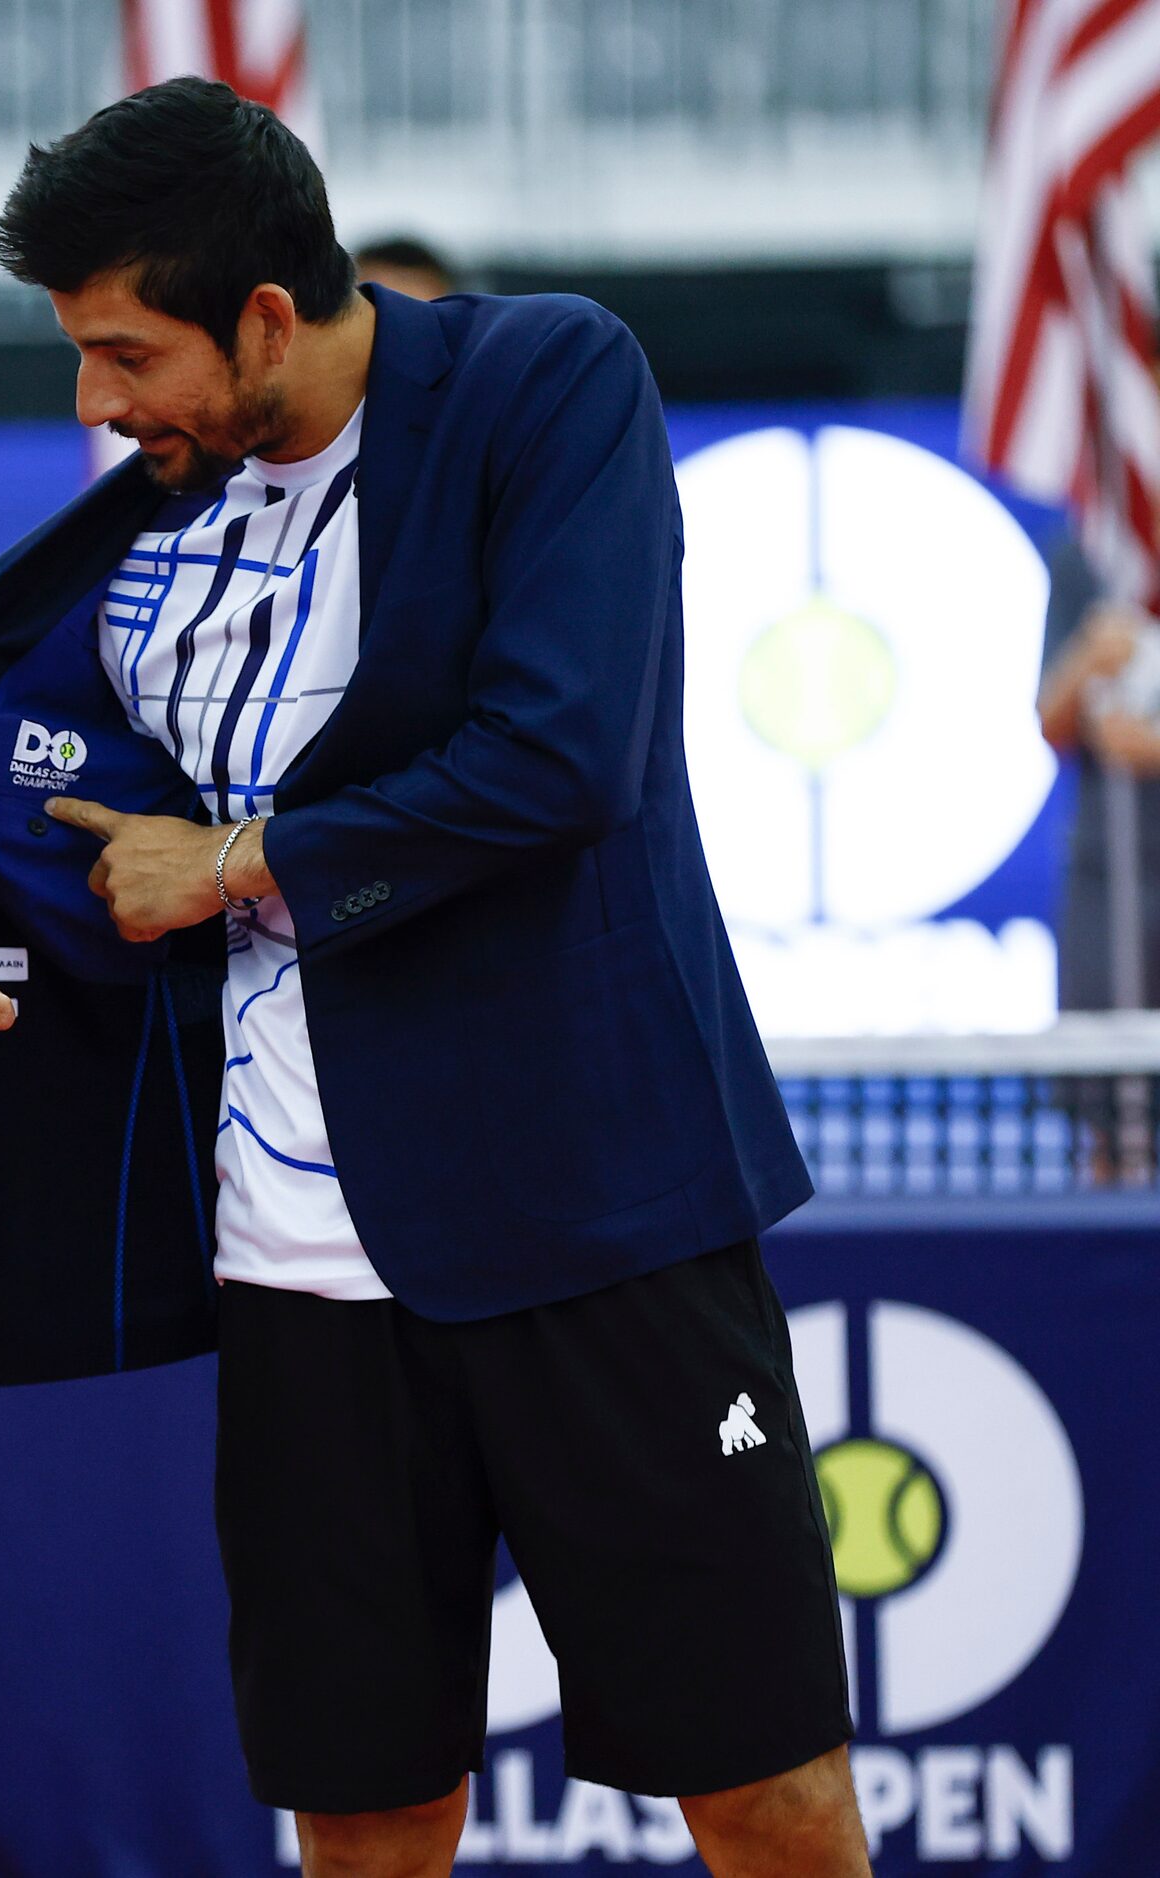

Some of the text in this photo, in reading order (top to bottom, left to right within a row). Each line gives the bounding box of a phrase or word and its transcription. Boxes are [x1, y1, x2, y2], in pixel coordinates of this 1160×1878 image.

[9, 760, 51, 778] DALLAS
[12, 773, 68, 791] CHAMPION
[848, 1743, 1075, 1863] PEN
